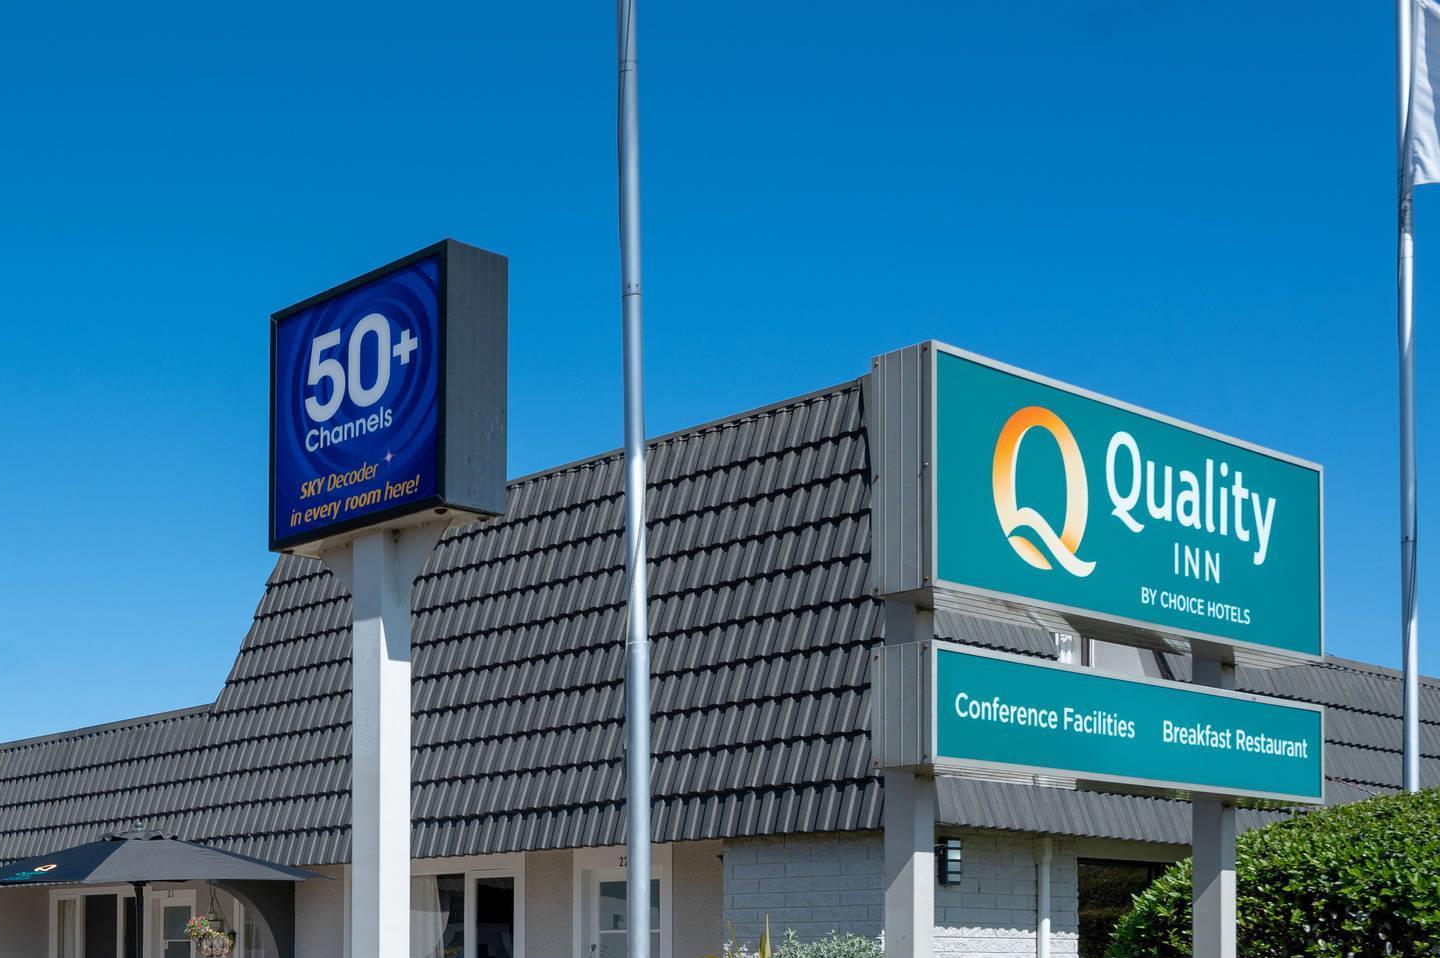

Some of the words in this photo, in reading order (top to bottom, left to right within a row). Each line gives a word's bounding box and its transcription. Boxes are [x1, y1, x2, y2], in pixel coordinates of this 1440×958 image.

[305, 313, 418, 422] 50+
[305, 406, 393, 452] Channels
[290, 509, 302, 527] in
[304, 500, 342, 522] every
[344, 488, 381, 512] room
[383, 473, 421, 501] here!
[300, 476, 325, 500] SKY
[327, 461, 379, 492] Decoder
[1105, 431, 1277, 566] Quality
[1174, 542, 1221, 585] INN
[1141, 586, 1157, 606] BY
[1160, 591, 1205, 617] CHOICE
[1207, 601, 1251, 625] HOTELS
[954, 692, 1059, 729] Conference
[1063, 707, 1136, 739] Facilities
[1163, 720, 1232, 750] Breakfast
[1235, 729, 1309, 759] Restaurant
